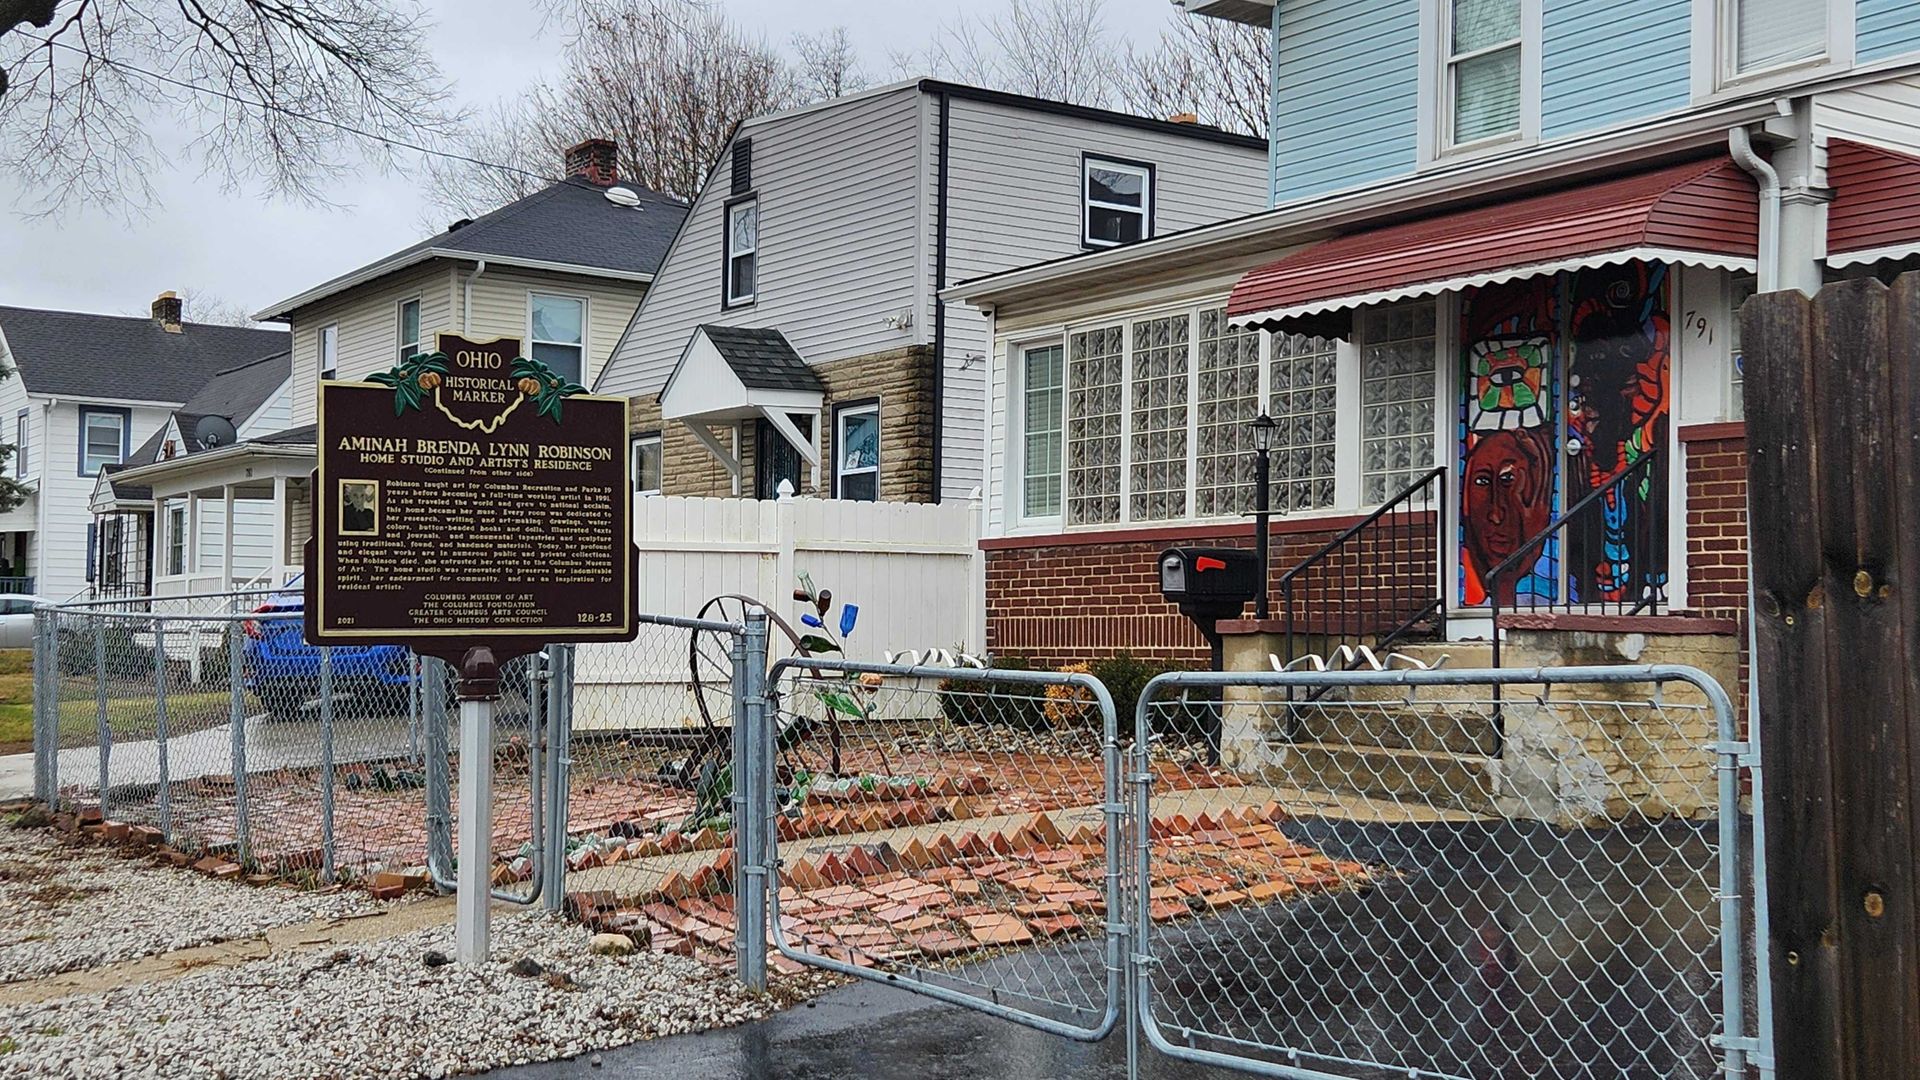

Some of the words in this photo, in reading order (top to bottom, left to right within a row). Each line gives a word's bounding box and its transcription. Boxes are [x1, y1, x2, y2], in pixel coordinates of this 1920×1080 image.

[1685, 310, 1713, 345] 791
[456, 350, 502, 370] OHIO
[445, 376, 515, 391] HISTORICAL
[453, 390, 506, 404] MARKER
[338, 436, 407, 452] AMINAH
[416, 439, 480, 455] BRENDA
[489, 442, 528, 457] LYNN
[538, 445, 611, 460] ROBINSON
[360, 453, 394, 463] HOME
[400, 454, 443, 465] STUDIO
[449, 456, 473, 466] AND
[479, 457, 528, 468] ARTIST'S
[534, 459, 591, 470] RESIDENCE
[386, 479, 419, 487] Robinson
[424, 481, 448, 489] taught
[442, 490, 477, 498] becoming
[577, 613, 611, 622] 128-25
